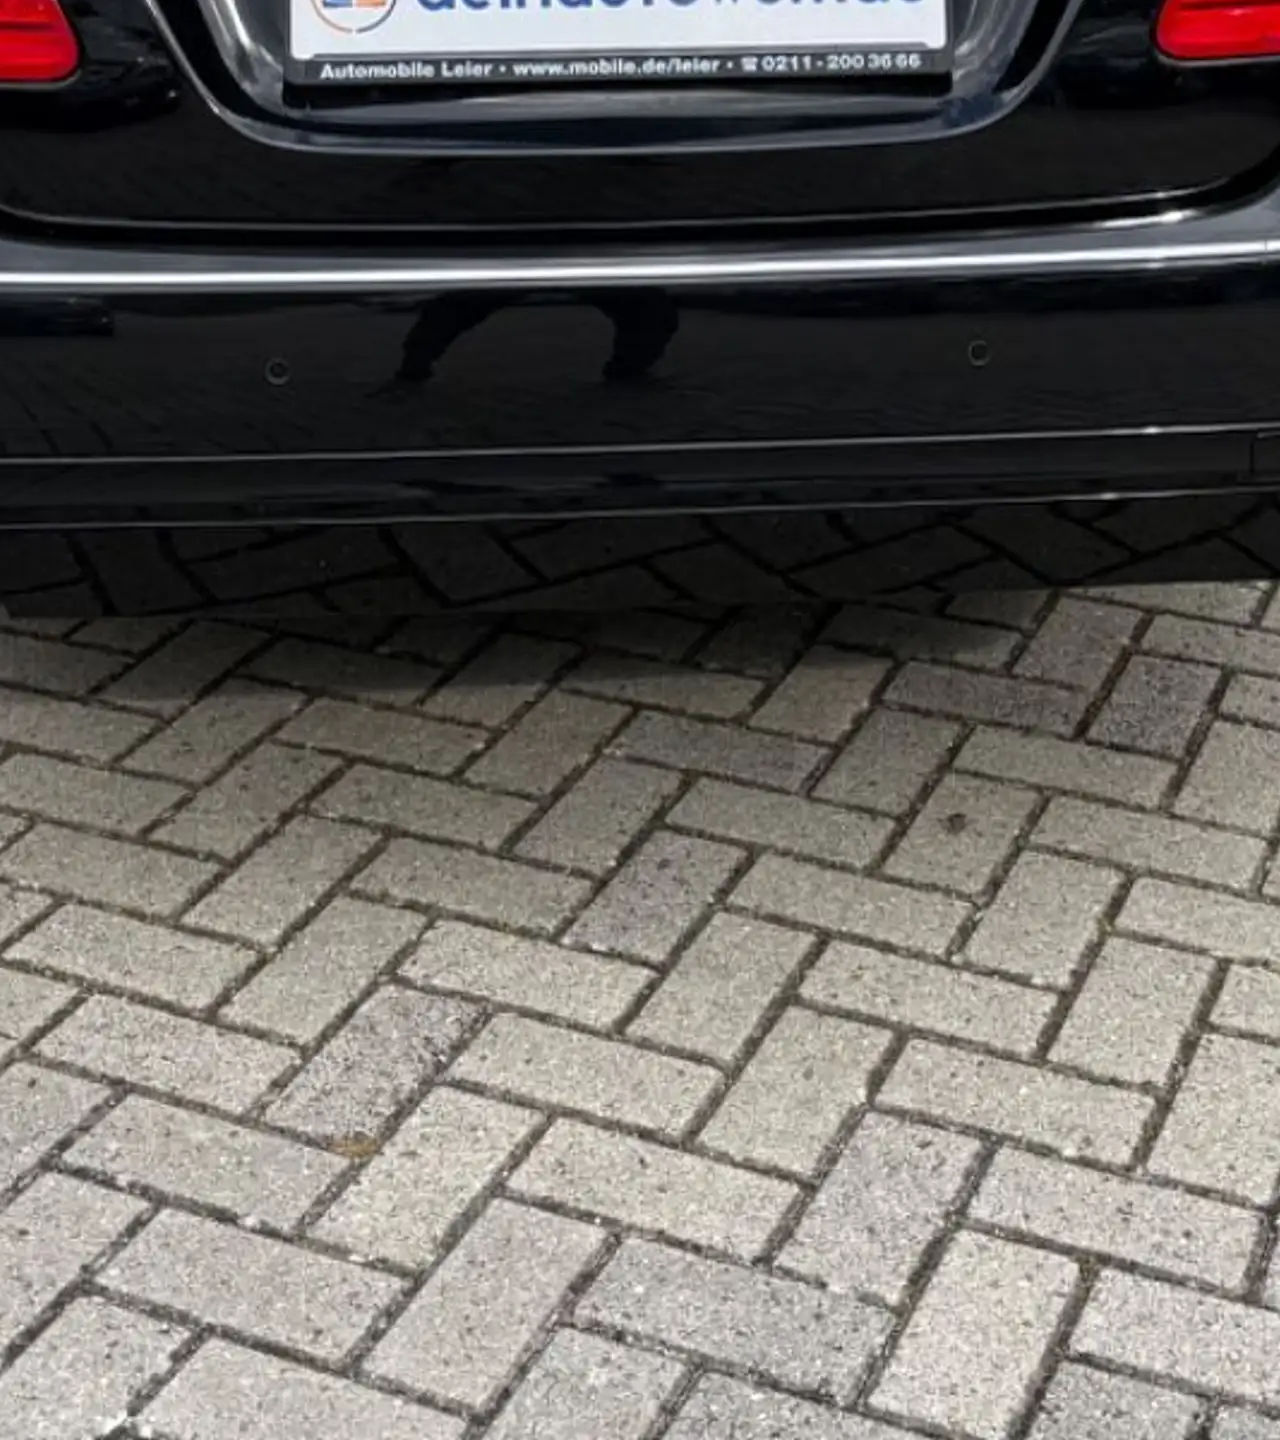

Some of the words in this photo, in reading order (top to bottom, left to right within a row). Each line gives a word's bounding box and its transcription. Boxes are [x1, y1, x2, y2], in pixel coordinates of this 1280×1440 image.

[319, 62, 436, 80] Automobile
[441, 61, 493, 78] Leier
[512, 56, 721, 78] www.mobile.de/leier
